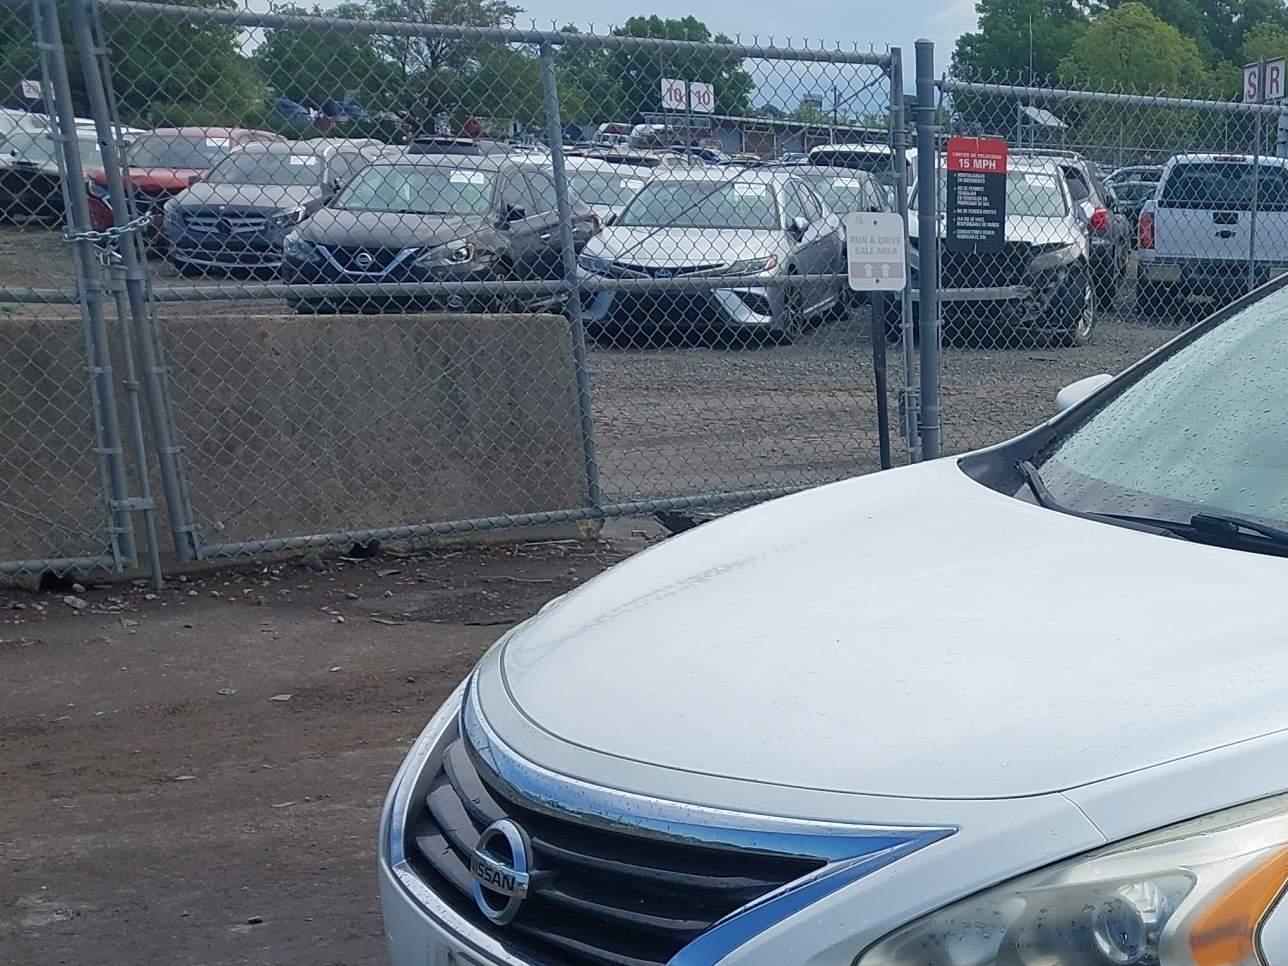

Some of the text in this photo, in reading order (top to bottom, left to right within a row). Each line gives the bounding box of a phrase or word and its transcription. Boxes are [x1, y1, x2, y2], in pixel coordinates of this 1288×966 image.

[1248, 71, 1257, 99] S
[1270, 65, 1280, 94] R
[666, 87, 682, 102] 10
[695, 90, 710, 105] 10
[958, 158, 996, 169] 15 MPH
[850, 236, 867, 244] RUN
[878, 236, 901, 244] DRIVE
[855, 247, 898, 255] SALE AREA
[471, 862, 516, 891] NISSAN
